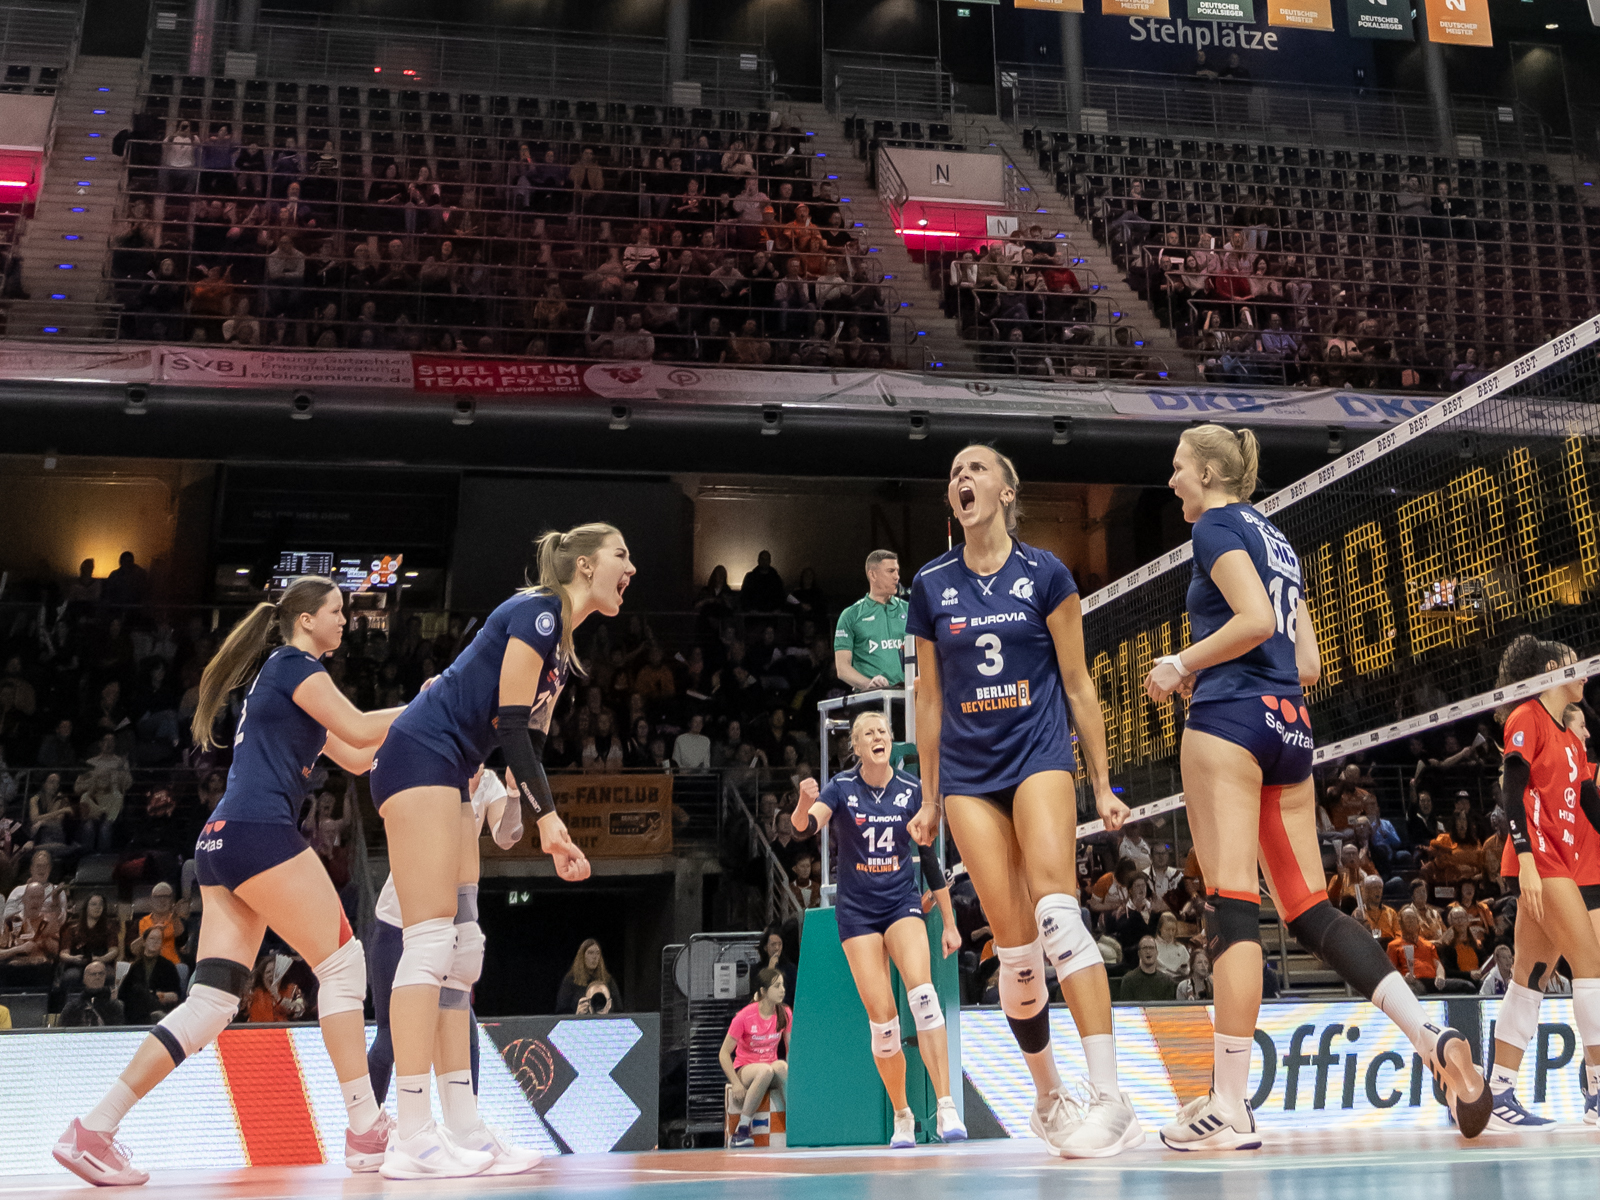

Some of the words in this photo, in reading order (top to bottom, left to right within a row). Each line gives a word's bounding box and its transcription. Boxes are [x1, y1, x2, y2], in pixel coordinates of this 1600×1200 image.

[1120, 2, 1150, 11] MEISTER
[1200, 1, 1240, 11] DEUTSCHER
[1197, 8, 1244, 18] POKALSIEGER
[1279, 8, 1318, 18] DEUTSCHER
[1286, 14, 1314, 24] MEISTER
[1360, 14, 1400, 24] DEUTSCHER
[1358, 21, 1403, 31] POKALSIEGER
[1440, 20, 1478, 30] DEUTSCHER
[1128, 16, 1278, 52] Stehplätze
[1445, 28, 1474, 36] MEISTER
[936, 164, 950, 183] N
[997, 218, 1008, 234] N
[172, 358, 235, 372] SVB
[323, 356, 411, 367] Gutachten
[262, 361, 401, 376] Energieberatung
[418, 364, 494, 376] SPIEL
[498, 365, 542, 376] MIT
[549, 365, 578, 376] IM
[250, 371, 411, 384] svbingenieure.de
[419, 376, 494, 388] TEAM
[1088, 594, 1100, 608] BEST
[1106, 583, 1120, 598] BEST
[1126, 572, 1140, 588] BEST
[1147, 561, 1162, 576] BEST
[1168, 549, 1182, 564] BEST
[1264, 496, 1281, 514] BEST
[1290, 481, 1308, 499] BEST
[1318, 466, 1336, 484] BEST
[1346, 450, 1366, 468] BEST
[1376, 432, 1396, 452] BEST
[1408, 415, 1430, 435] BEST
[1442, 396, 1464, 417] BEST
[1477, 376, 1500, 398] BEST
[1514, 355, 1538, 378] BEST
[1552, 333, 1578, 357] BEST
[1268, 576, 1300, 644] 18
[970, 612, 1027, 627] EUROVIA
[881, 638, 905, 650] DEKR
[974, 632, 1005, 676] 3
[976, 684, 1017, 700] BERLIN
[960, 696, 1018, 714] RECYCLING
[868, 815, 902, 823] EUROVIA
[862, 826, 896, 853] 14
[868, 857, 892, 866] BERLIN
[856, 863, 892, 873] RECYCLING
